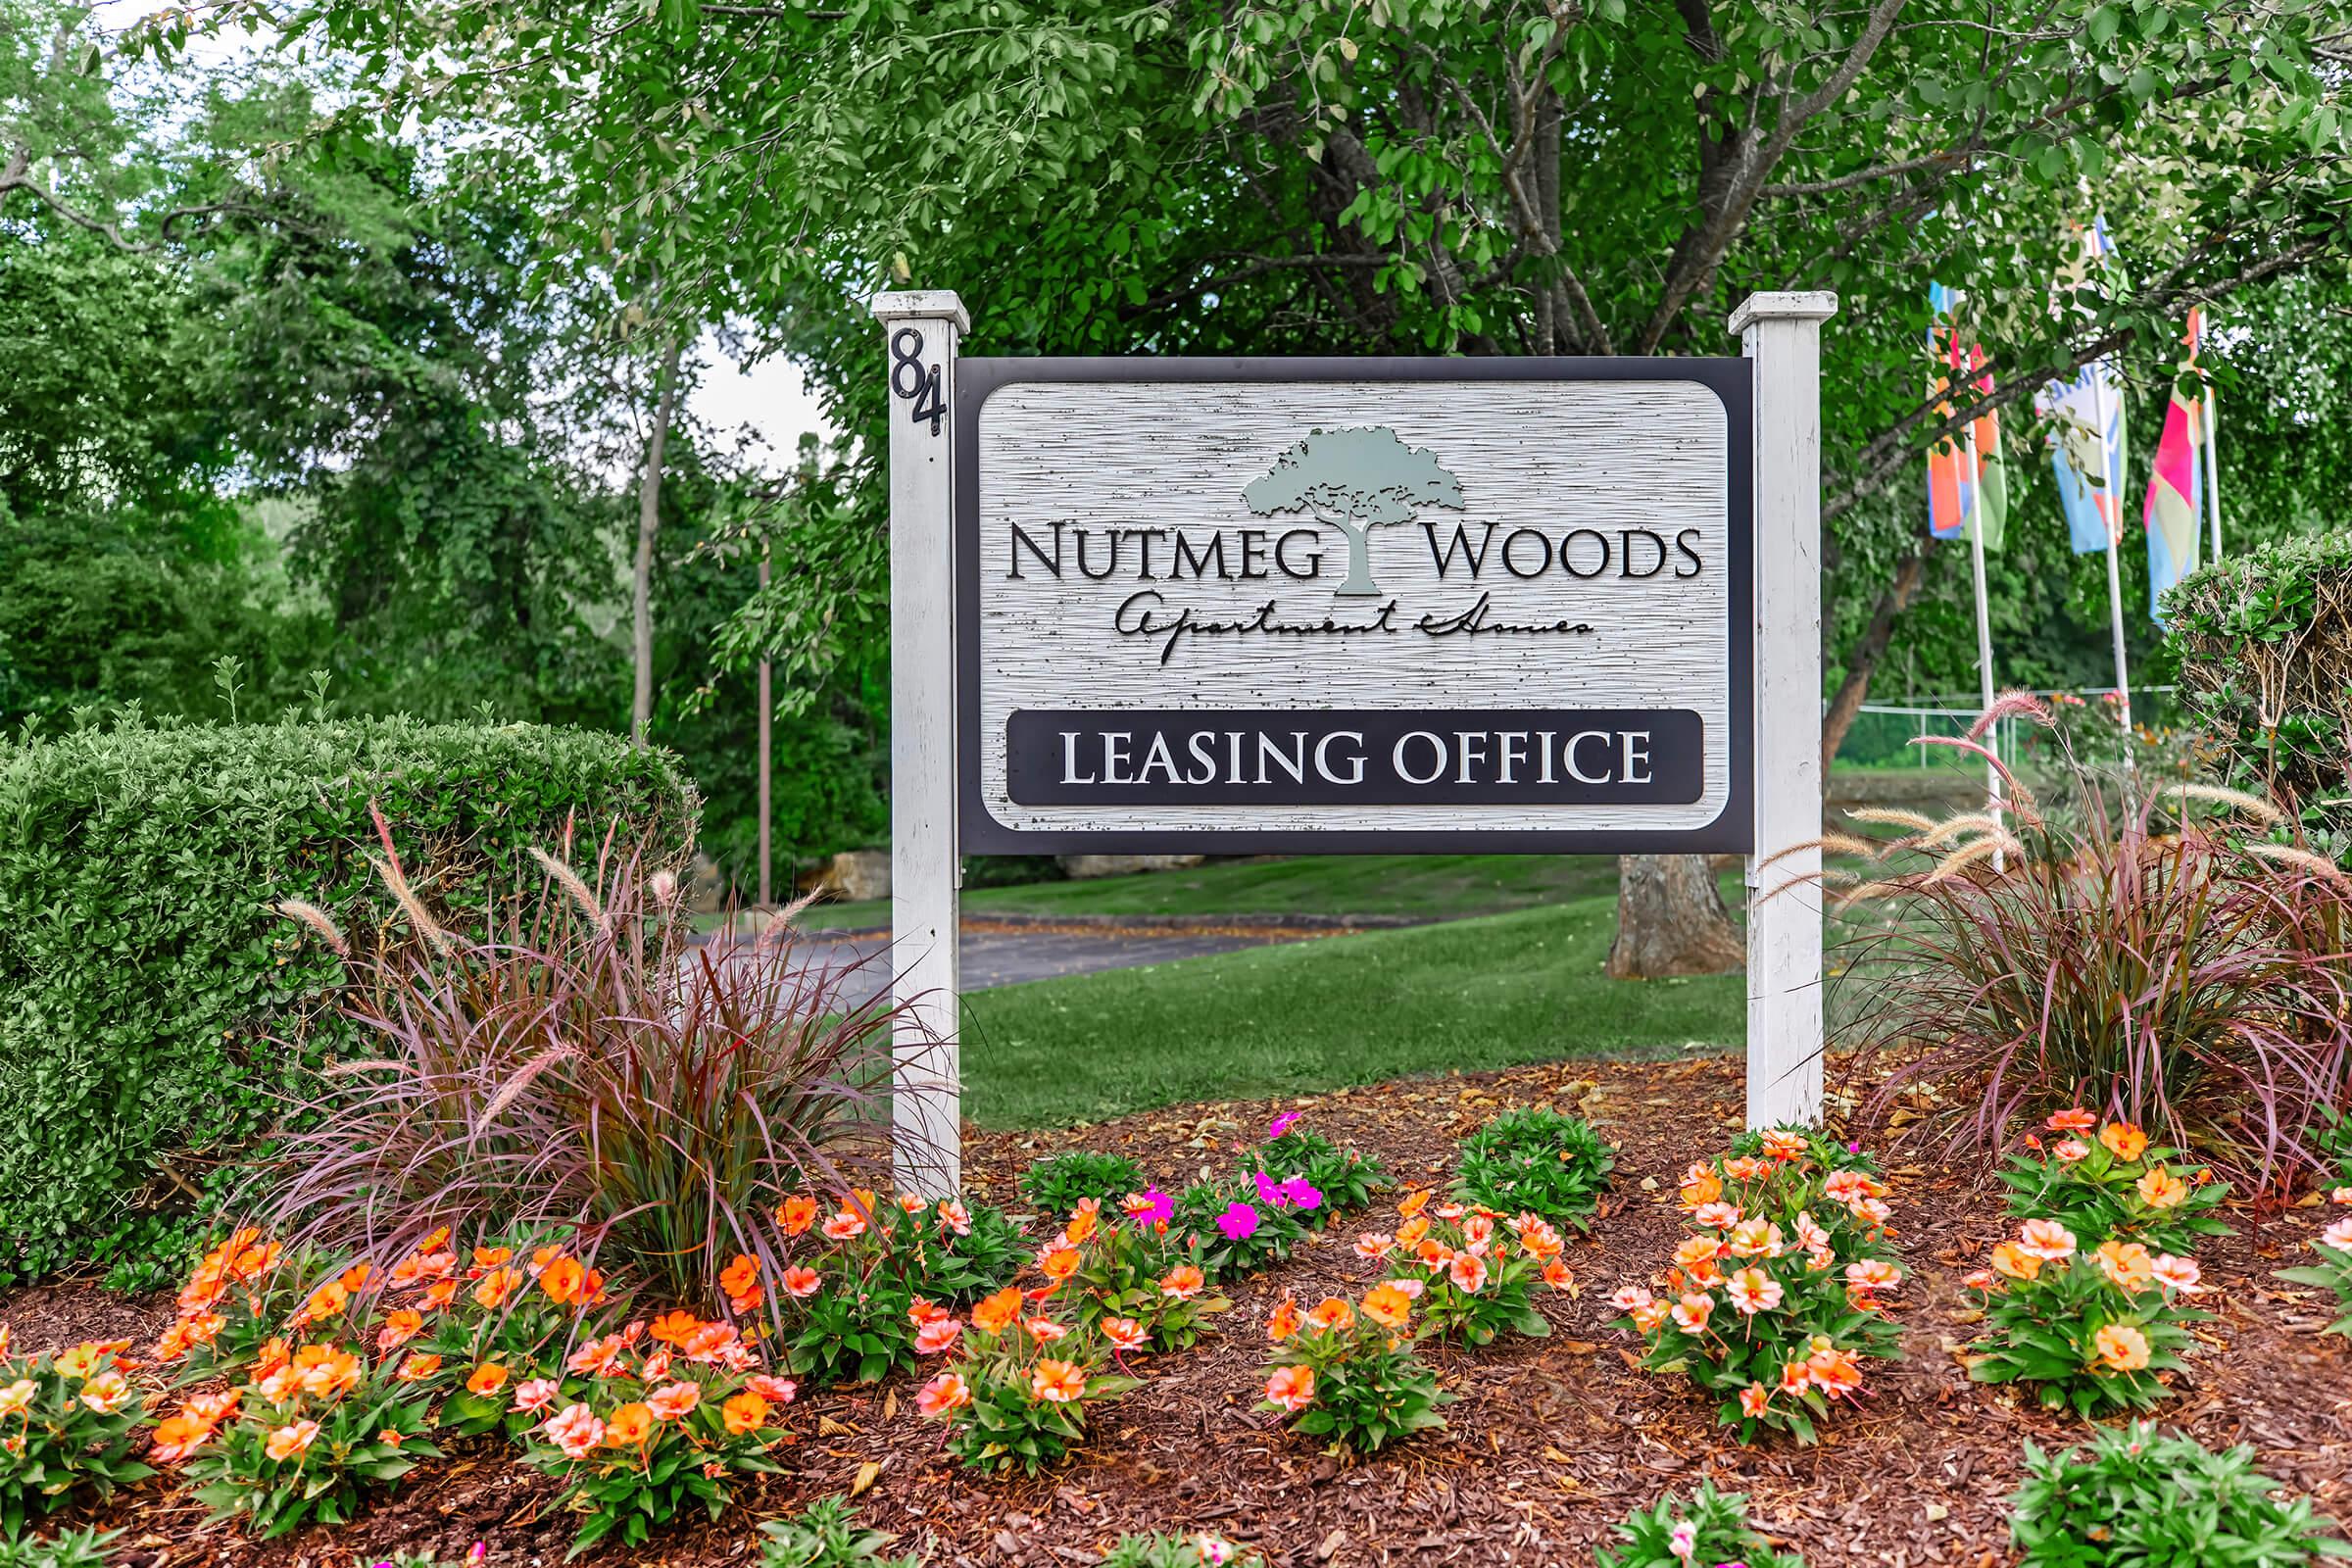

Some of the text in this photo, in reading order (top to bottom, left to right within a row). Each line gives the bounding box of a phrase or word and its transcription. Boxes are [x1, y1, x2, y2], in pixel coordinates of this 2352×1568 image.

[891, 327, 948, 437] 84
[1005, 519, 1702, 580] NUTMEG WOODS
[1114, 590, 1594, 665] Apartment Homes
[1058, 731, 1652, 785] LEASING OFFICE
